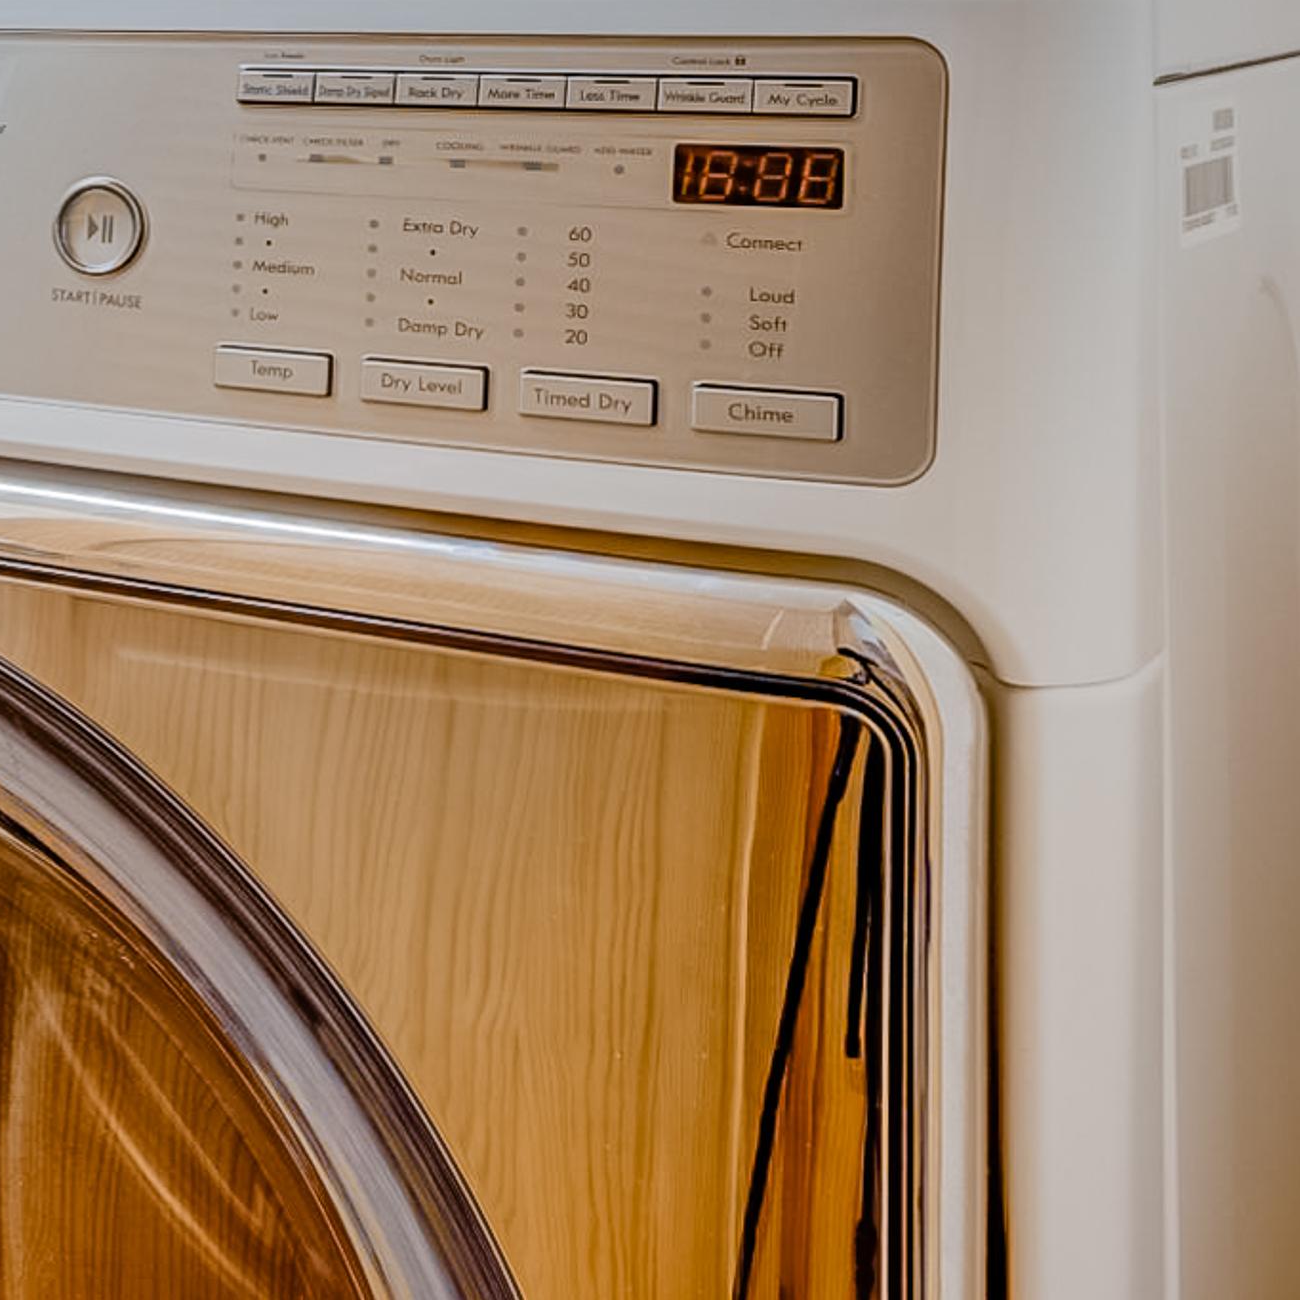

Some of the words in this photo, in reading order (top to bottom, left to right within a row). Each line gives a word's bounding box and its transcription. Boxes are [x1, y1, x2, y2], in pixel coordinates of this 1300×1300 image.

[408, 87, 437, 98] Rack
[441, 87, 463, 100] Dry
[488, 88, 520, 100] More
[524, 89, 555, 101] Time
[609, 90, 640, 102] Time
[768, 94, 791, 107] My
[796, 93, 838, 107] Cycle
[254, 212, 289, 228] High
[403, 218, 444, 234] Extra
[449, 221, 480, 238] Dry
[568, 226, 592, 243] 60
[726, 232, 803, 252] Connect
[252, 260, 316, 276] Medium
[567, 252, 591, 268] 50
[400, 268, 463, 285] Normal
[566, 277, 591, 293] 40
[749, 287, 796, 305] Loud
[250, 307, 280, 322] Low
[565, 303, 589, 320] 30
[398, 318, 448, 337] Damp
[455, 321, 484, 340] Dry
[749, 315, 787, 333] Soft
[564, 329, 588, 345] 20
[748, 341, 784, 360] Off
[250, 360, 293, 380] Temp
[381, 373, 412, 393] Dry
[418, 375, 463, 396] Level
[533, 387, 590, 410] Timed
[599, 391, 632, 415] Dry
[727, 402, 794, 425] Chime
